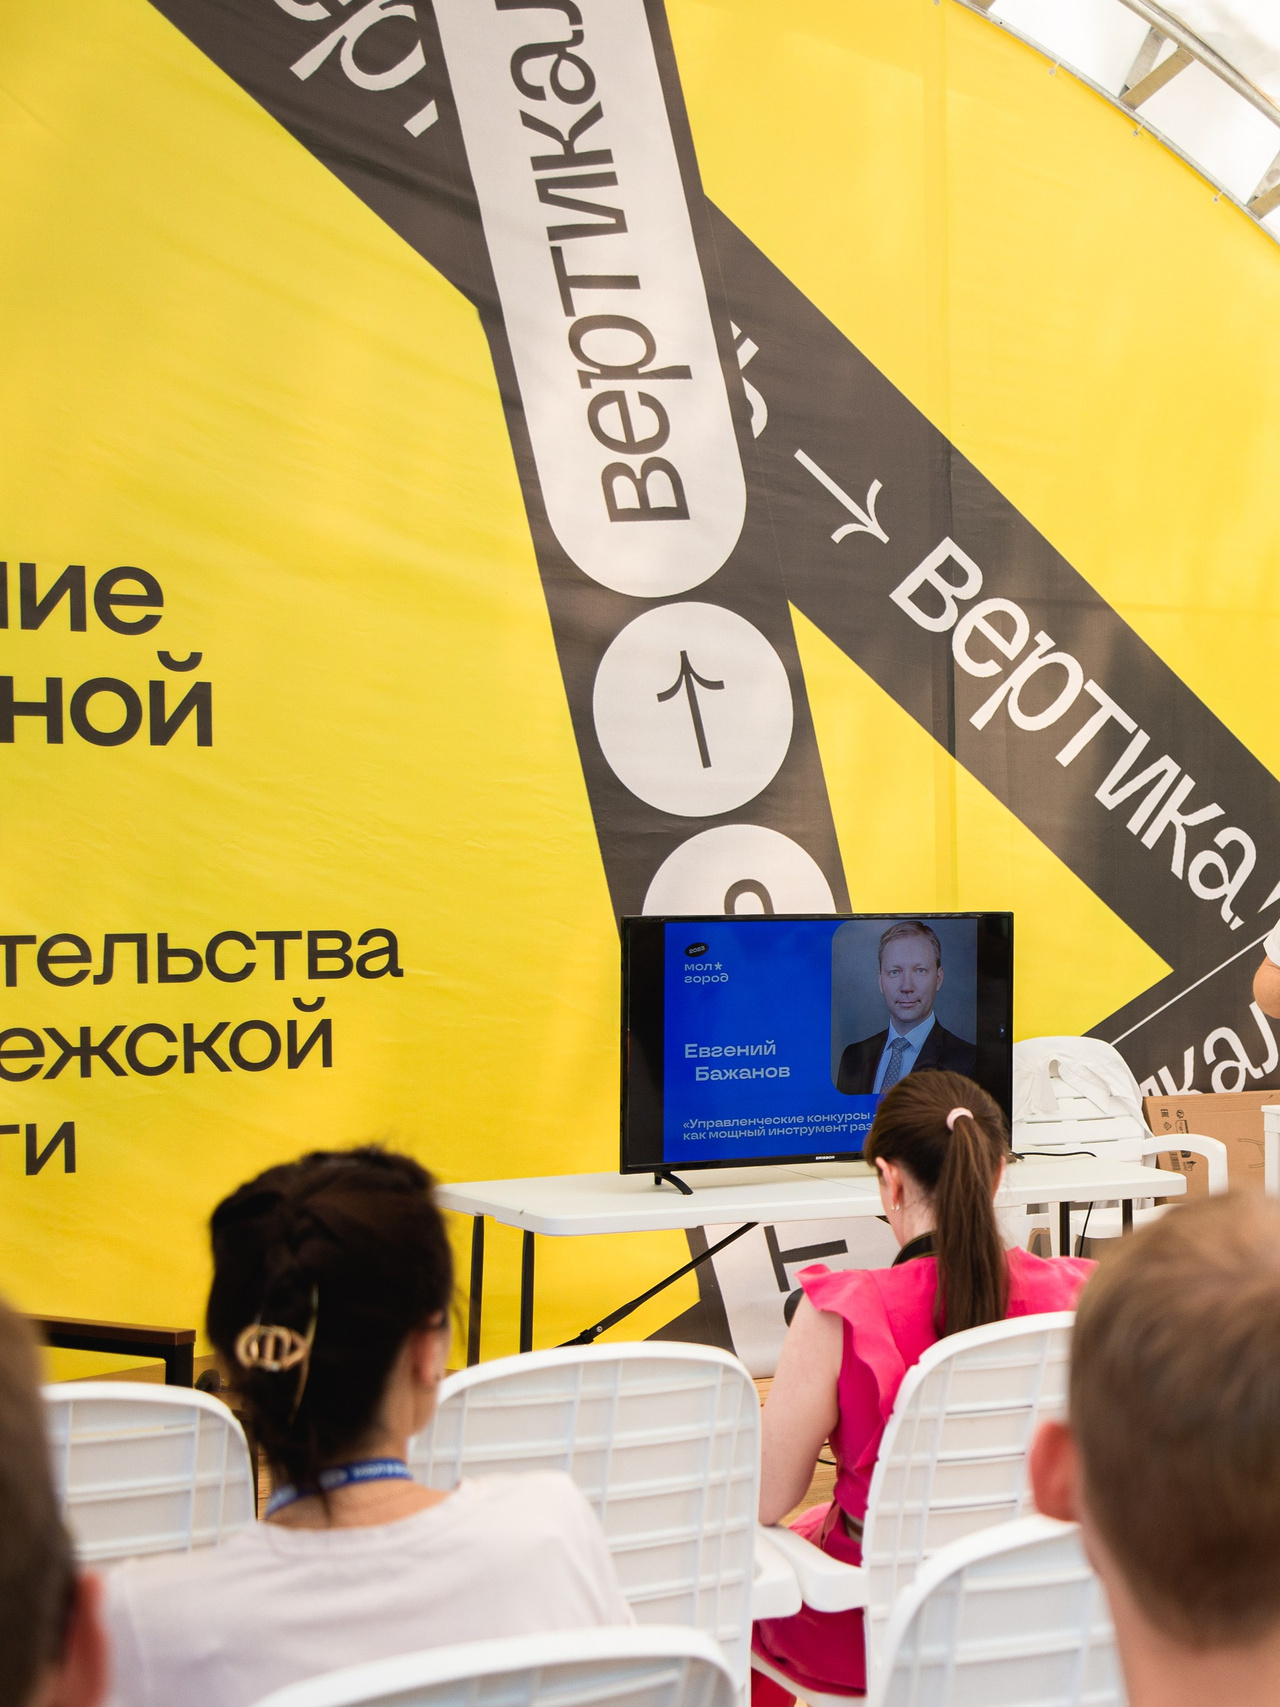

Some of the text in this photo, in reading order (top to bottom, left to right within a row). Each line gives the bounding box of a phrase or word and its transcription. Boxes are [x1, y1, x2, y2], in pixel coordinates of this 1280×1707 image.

[0, 650, 212, 747] ной
[0, 927, 403, 987] тельства
[688, 945, 706, 954] 2023
[684, 972, 729, 985] город
[0, 996, 333, 1082] ежской
[684, 1039, 776, 1058] Евгений
[695, 1066, 791, 1081] Бажанов
[683, 1111, 871, 1130] «Управленческие конкурсы
[683, 1122, 872, 1141] как мощный инструмент раз
